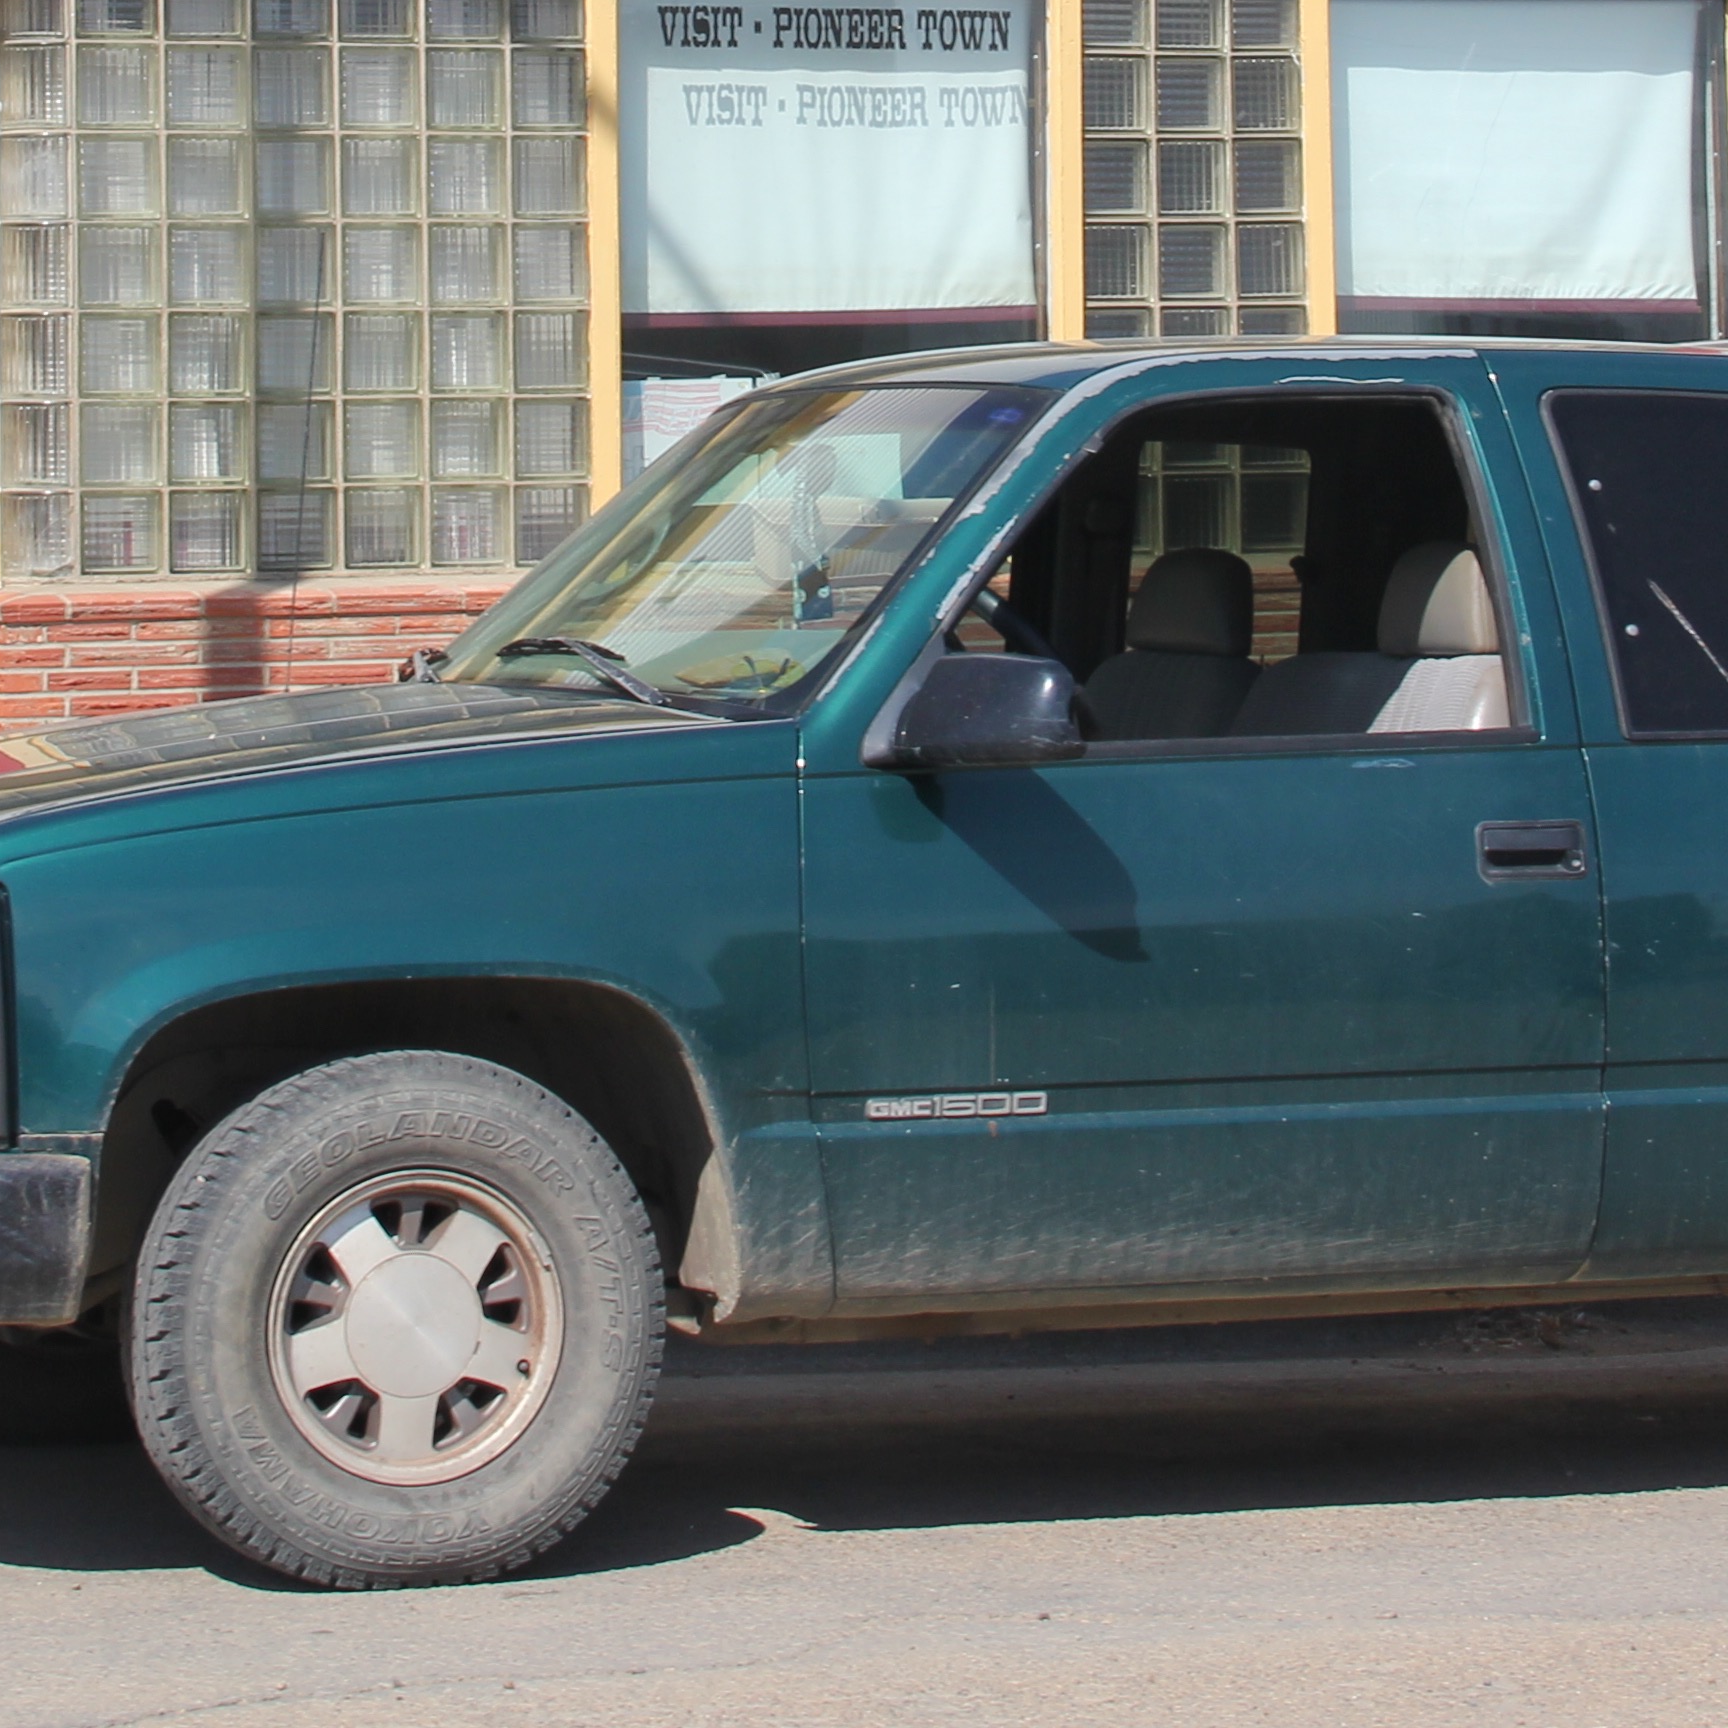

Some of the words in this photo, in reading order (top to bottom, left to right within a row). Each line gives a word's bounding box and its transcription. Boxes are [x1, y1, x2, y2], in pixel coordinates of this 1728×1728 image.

[656, 4, 744, 49] VISIT
[772, 7, 907, 51] PIONEER
[916, 9, 1012, 52] TOWN
[682, 82, 768, 127] VISIT
[795, 83, 930, 129] PIONEER
[263, 1109, 574, 1220] GEOLANDAR
